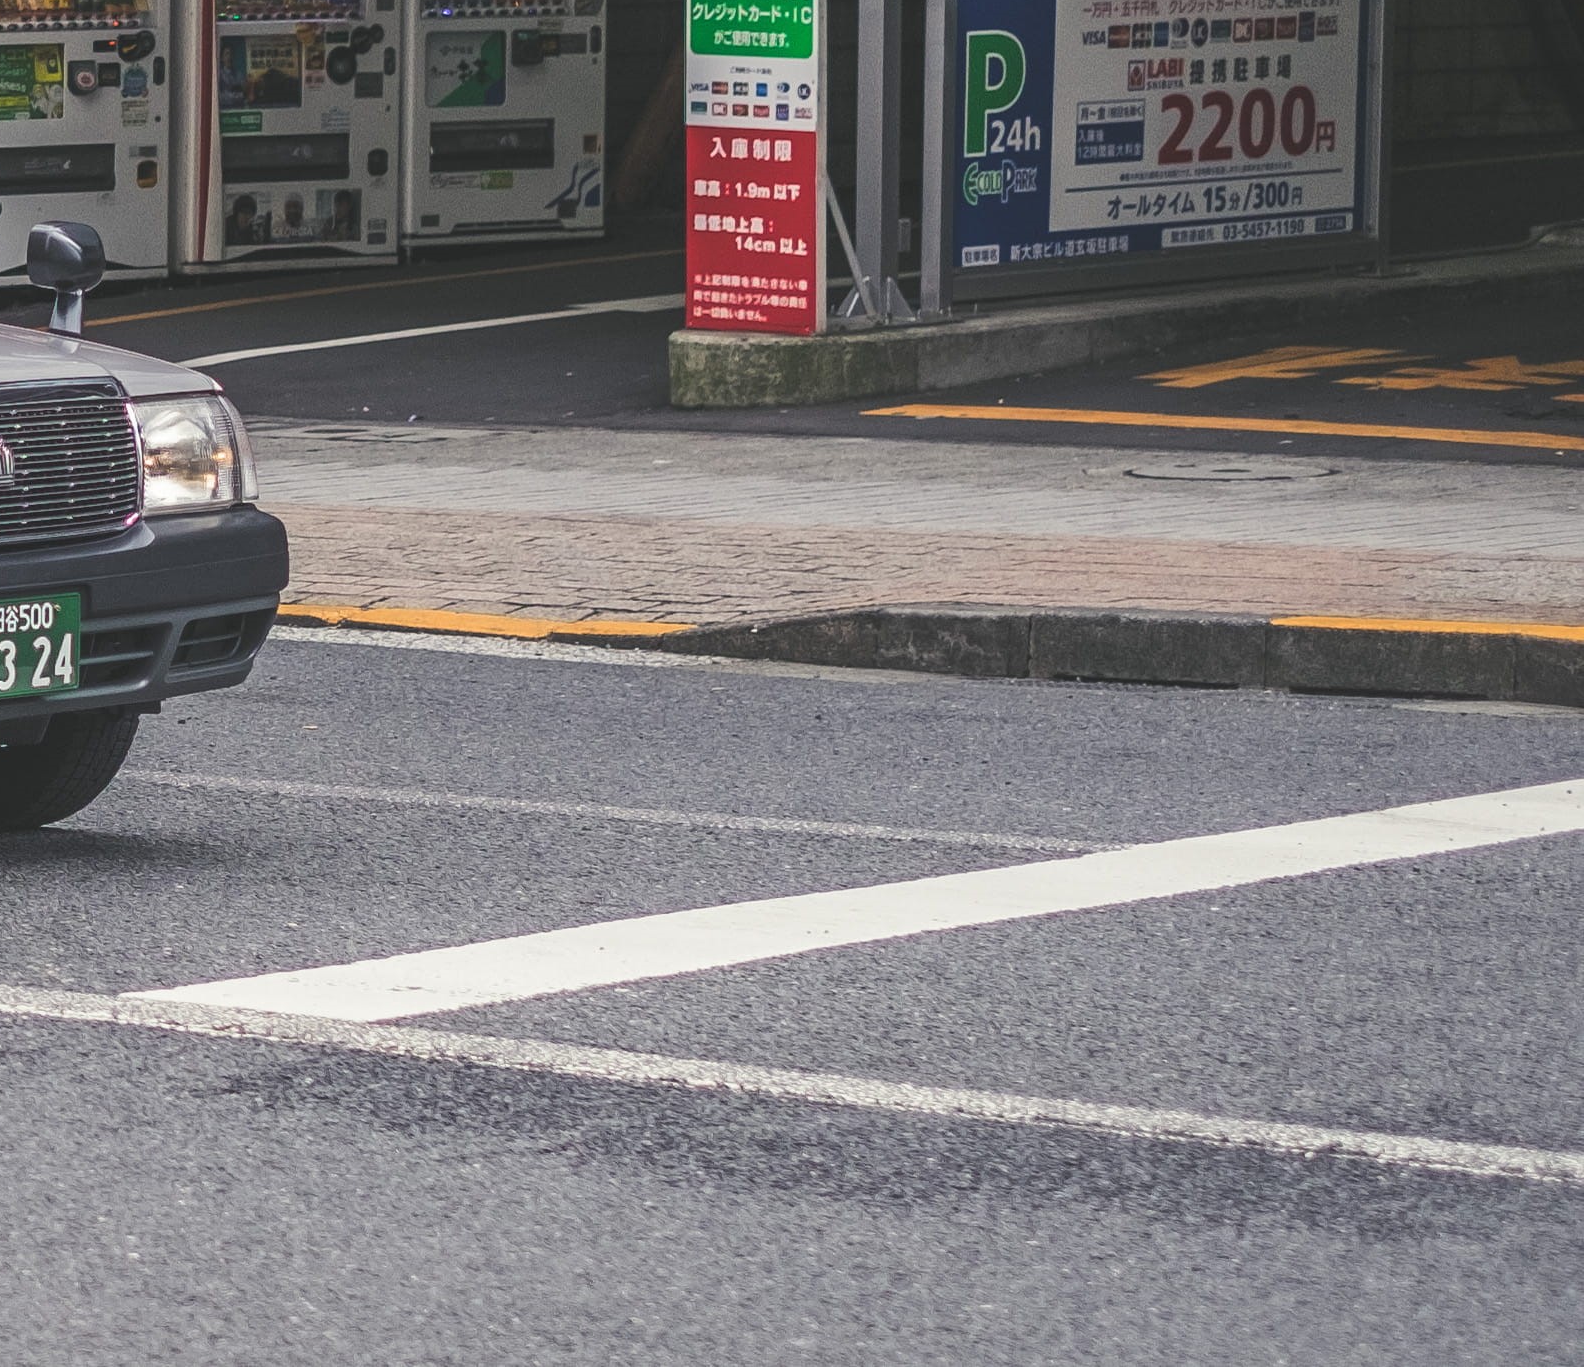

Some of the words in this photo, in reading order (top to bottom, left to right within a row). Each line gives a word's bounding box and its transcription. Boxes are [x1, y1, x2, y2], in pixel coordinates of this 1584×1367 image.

[1146, 58, 1185, 80] LABI
[1190, 54, 1292, 86] 提携駐車場
[964, 30, 1027, 158] P
[991, 116, 1041, 153] 24h
[1156, 85, 1336, 166] 2200円
[710, 137, 793, 162] 入庫制限
[1106, 193, 1195, 220] オールタイム
[1009, 234, 1130, 261] 新大宗ビル道玄坂駐車場
